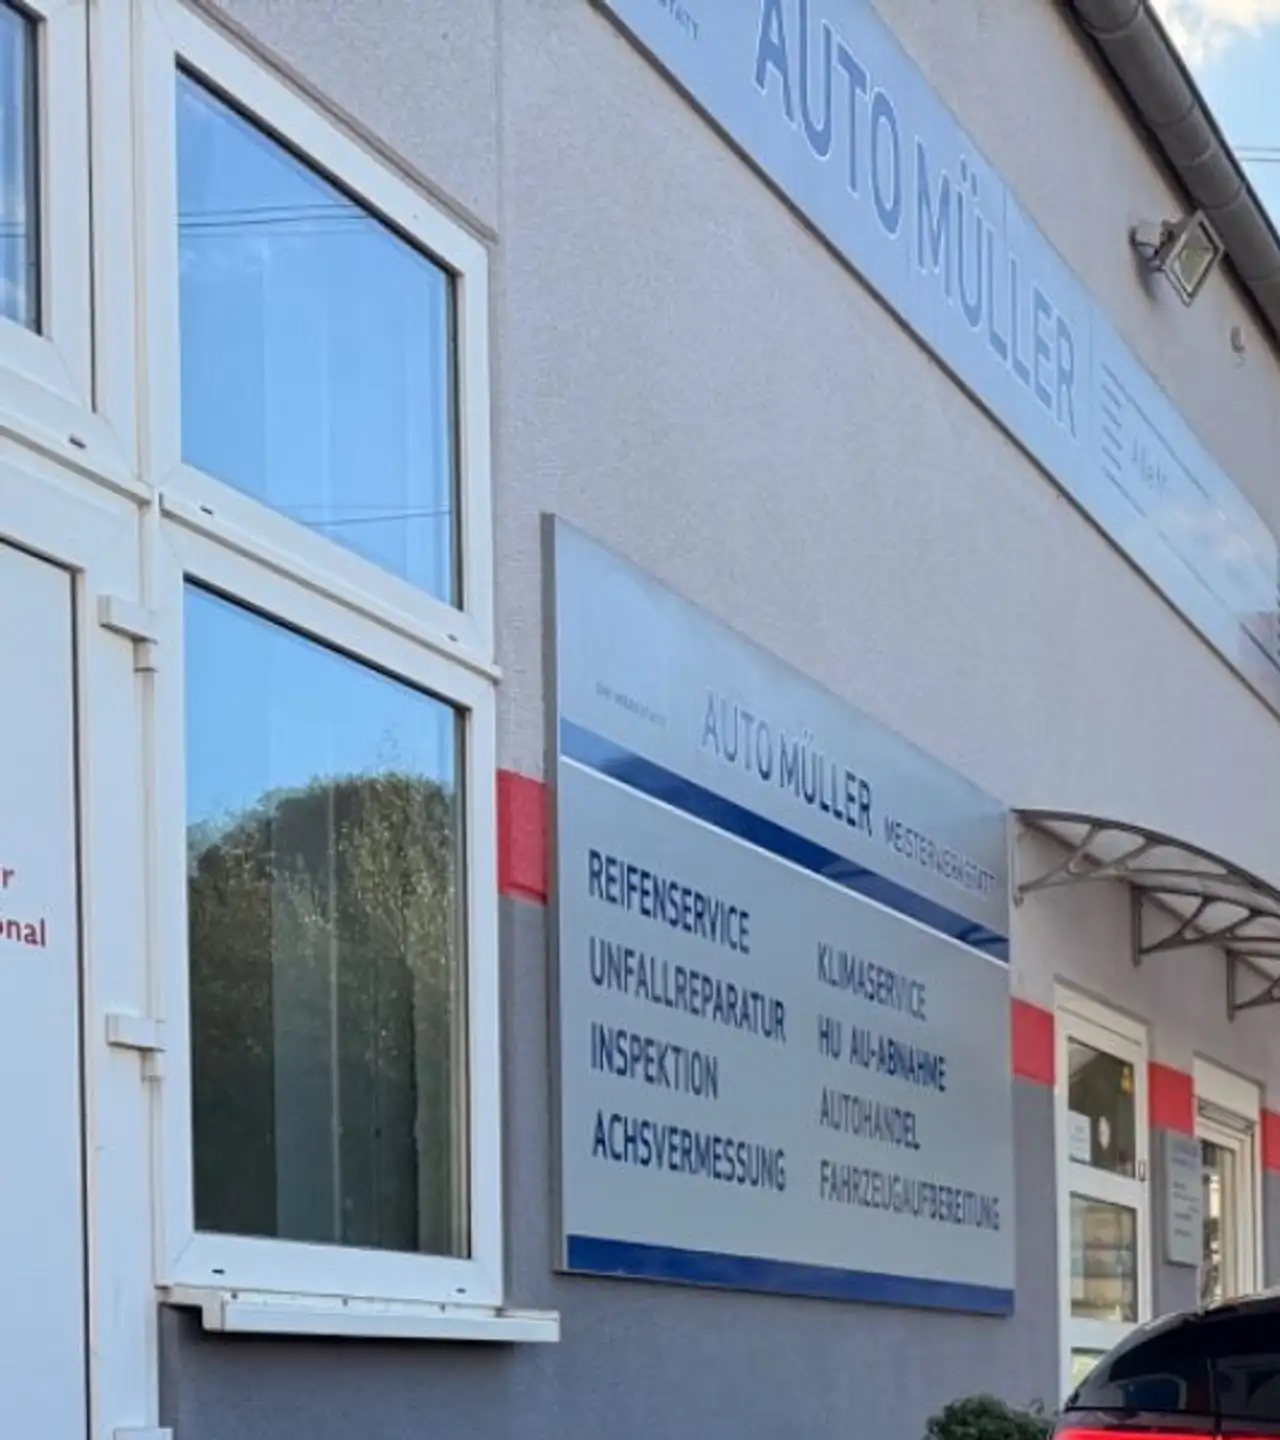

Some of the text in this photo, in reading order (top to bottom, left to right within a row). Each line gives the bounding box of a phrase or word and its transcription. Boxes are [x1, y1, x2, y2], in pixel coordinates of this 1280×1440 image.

[756, 0, 1078, 440] AUTO MÜLLER
[702, 688, 774, 781] AUTO
[780, 729, 873, 837] MÜLLER
[588, 849, 751, 954] REIFENSERVICE
[589, 936, 786, 1044] UNFALLREPARATUR
[817, 941, 927, 1022] KLIMASERVICE
[591, 1021, 719, 1100] INSPEKTION
[818, 1014, 842, 1060] HU
[592, 1108, 787, 1192] ACHSVERMESSUNG
[820, 1087, 921, 1151] AUTOHANDEL
[820, 1160, 1001, 1232] FAHRZEUGAUFBEREITUNG
